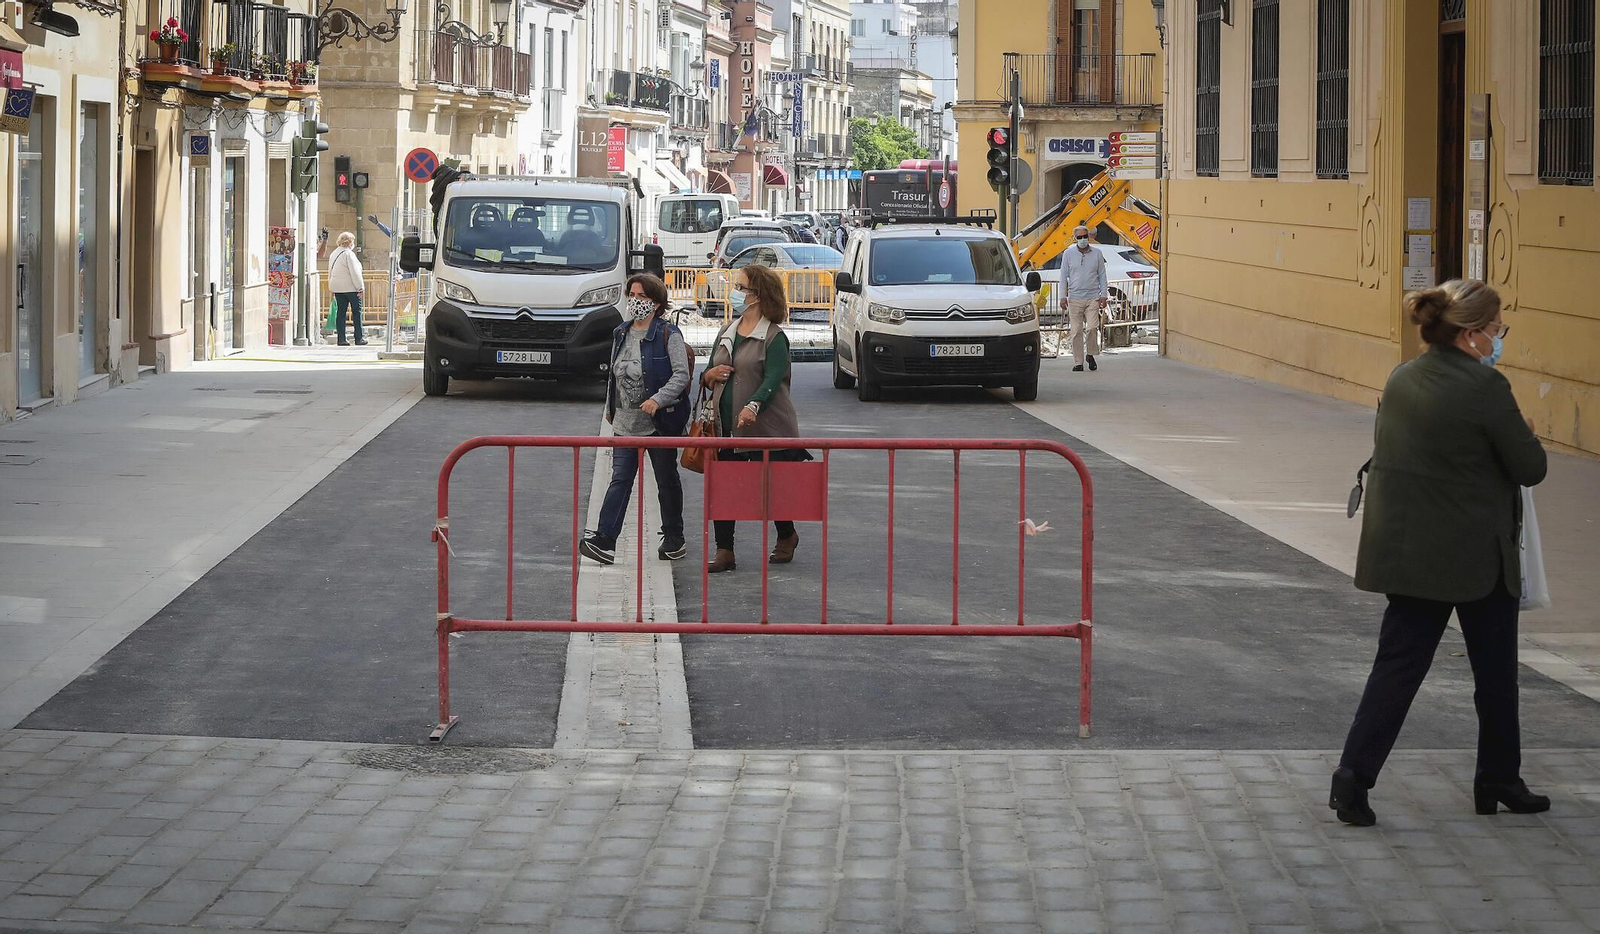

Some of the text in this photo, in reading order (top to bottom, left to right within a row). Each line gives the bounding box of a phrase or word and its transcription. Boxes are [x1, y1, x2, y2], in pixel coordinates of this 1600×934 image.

[770, 72, 802, 81] HOTEL
[579, 130, 608, 147] L12
[1049, 139, 1095, 153] asisa
[765, 156, 783, 164] HOTEL
[892, 190, 926, 201] Trasur
[936, 345, 982, 355] 7823 LCP
[503, 353, 548, 362] 5728 LJX
